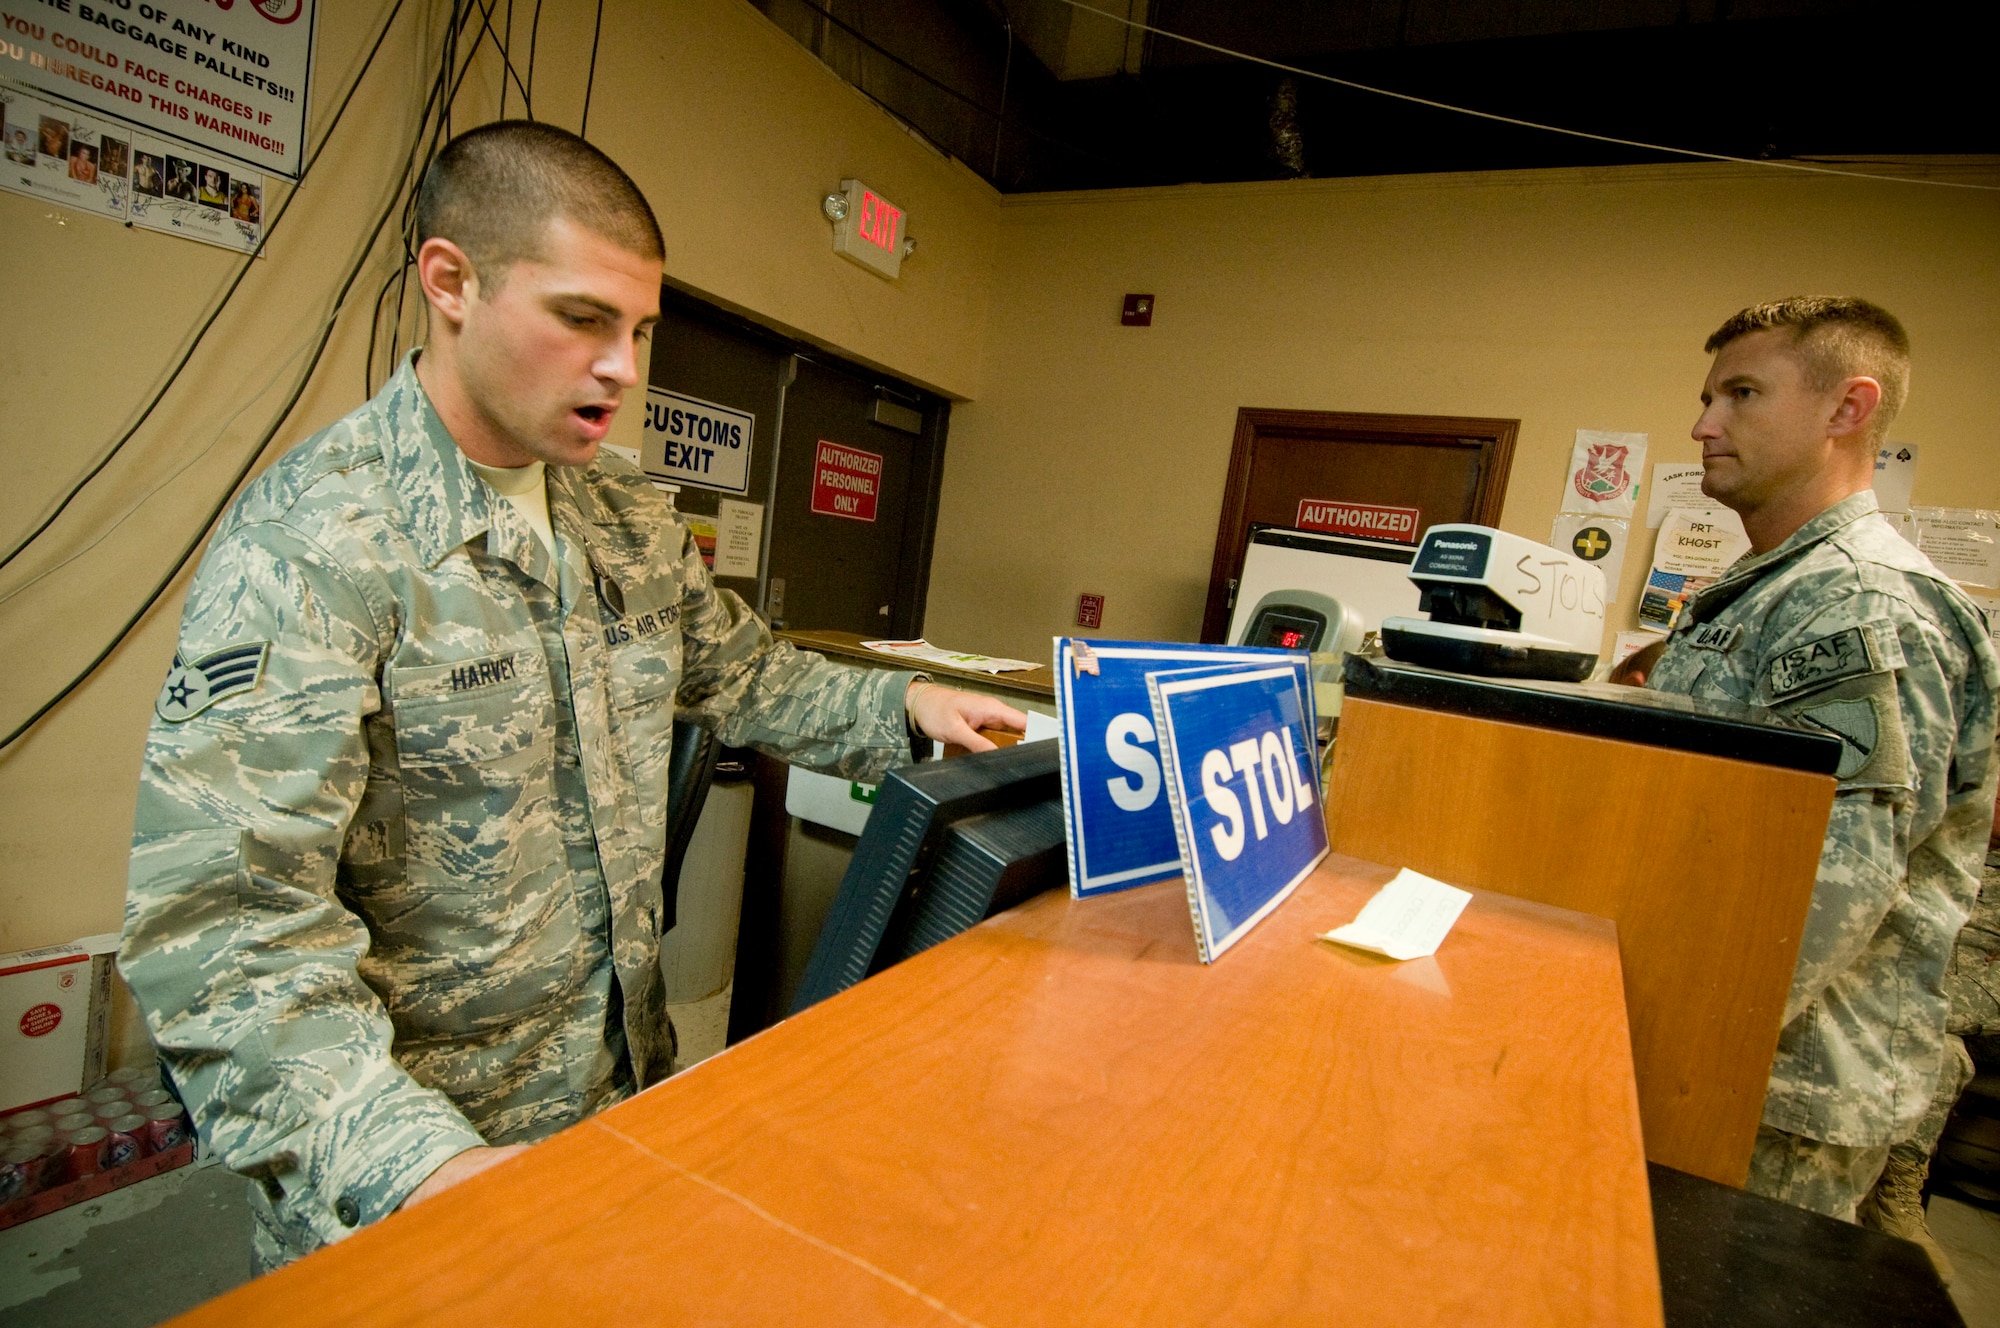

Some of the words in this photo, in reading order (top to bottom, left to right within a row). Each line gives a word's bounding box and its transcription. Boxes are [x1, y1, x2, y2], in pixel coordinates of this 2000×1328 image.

[139, 4, 168, 24] OF
[172, 18, 216, 45] ANY
[222, 38, 270, 68] KIND
[79, 4, 187, 60] BAGGAGE
[194, 51, 294, 103] PALLETS!!!
[2, 12, 45, 41] YOU
[51, 32, 119, 69] COULD
[124, 59, 169, 89] FACE
[175, 79, 253, 120] CHARGES
[258, 111, 273, 126] IF
[148, 94, 189, 121] THIS
[194, 111, 285, 156] WARNING!!!
[860, 190, 901, 254] EXIT
[664, 441, 714, 473] EXIT
[820, 446, 879, 475] AUTHORIZED
[820, 471, 875, 496] PERSONNEL
[1663, 472, 1683, 482] TASK
[834, 494, 859, 514] ONLY
[1302, 505, 1412, 532] AUTHORIZED
[1690, 523, 1714, 533] PRT
[1434, 539, 1478, 551] Panasonic
[1678, 536, 1721, 549] KHOST
[1429, 562, 1469, 572] COMMERCIAL
[605, 624, 634, 646] U.S.
[637, 613, 658, 637] AIR
[659, 601, 682, 628] FORC
[1781, 634, 1850, 673] ISAF
[452, 656, 518, 691] HARVEY
[1201, 726, 1313, 862] STOL
[21, 1023, 30, 1031] BY
[31, 1013, 61, 1029] SHIPPING
[27, 1012, 46, 1022] MORE
[30, 1006, 47, 1016] SAVE
[30, 1020, 54, 1033] ONLINE
